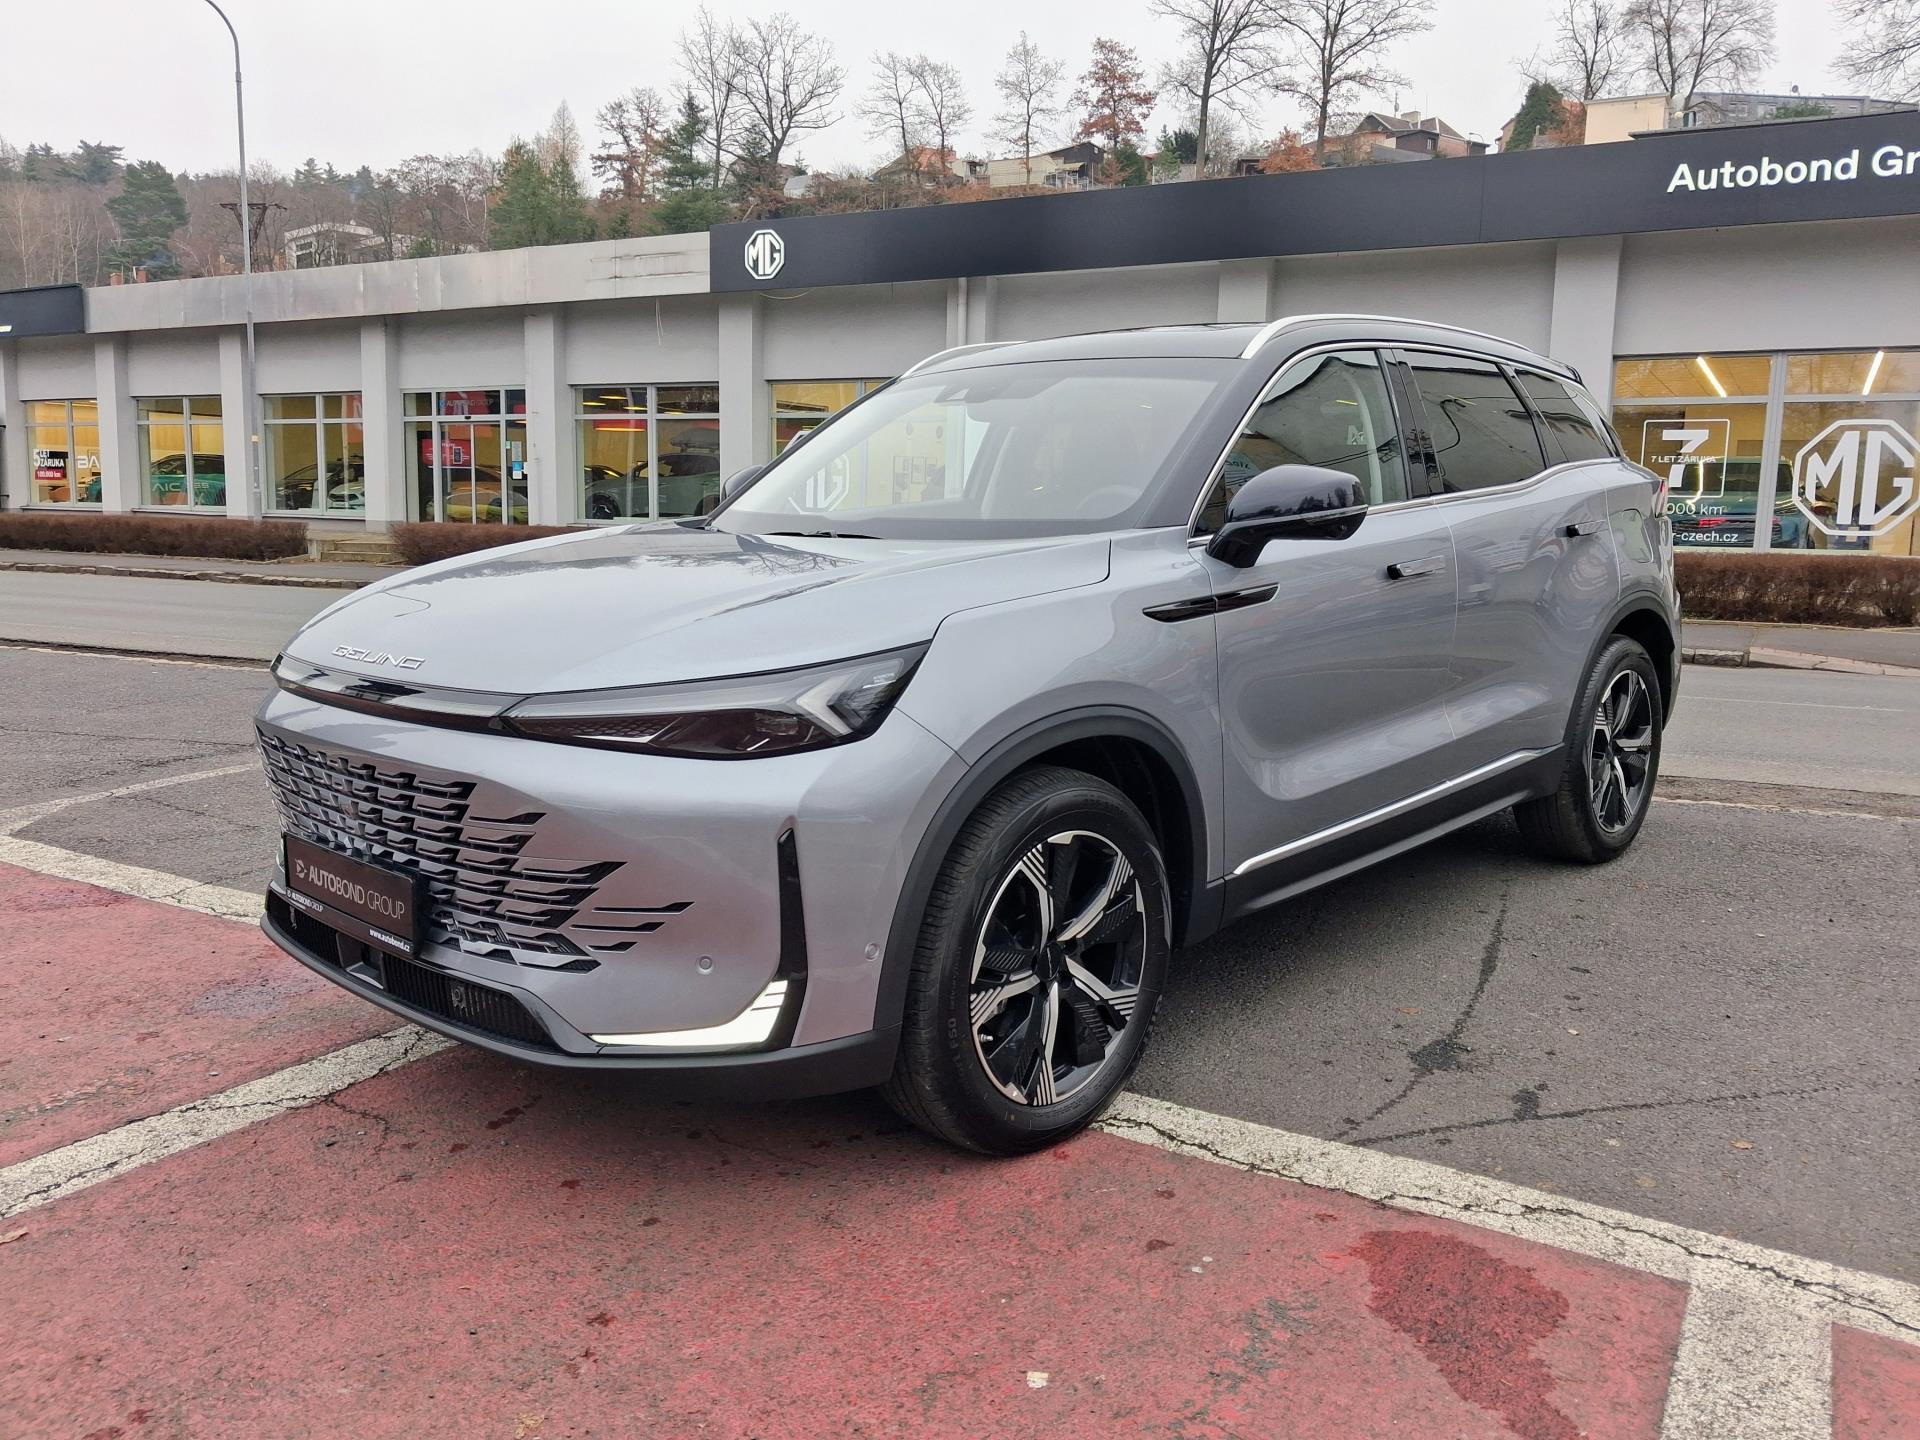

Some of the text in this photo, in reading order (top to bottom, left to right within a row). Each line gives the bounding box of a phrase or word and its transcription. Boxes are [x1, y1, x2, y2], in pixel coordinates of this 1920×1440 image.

[1667, 149, 1859, 193] Autobond
[748, 233, 781, 275] MG
[1658, 455, 1677, 463] LET
[1805, 430, 1915, 525] MG
[1700, 503, 1722, 516] km
[308, 865, 405, 920] AUTOBOND GROUP
